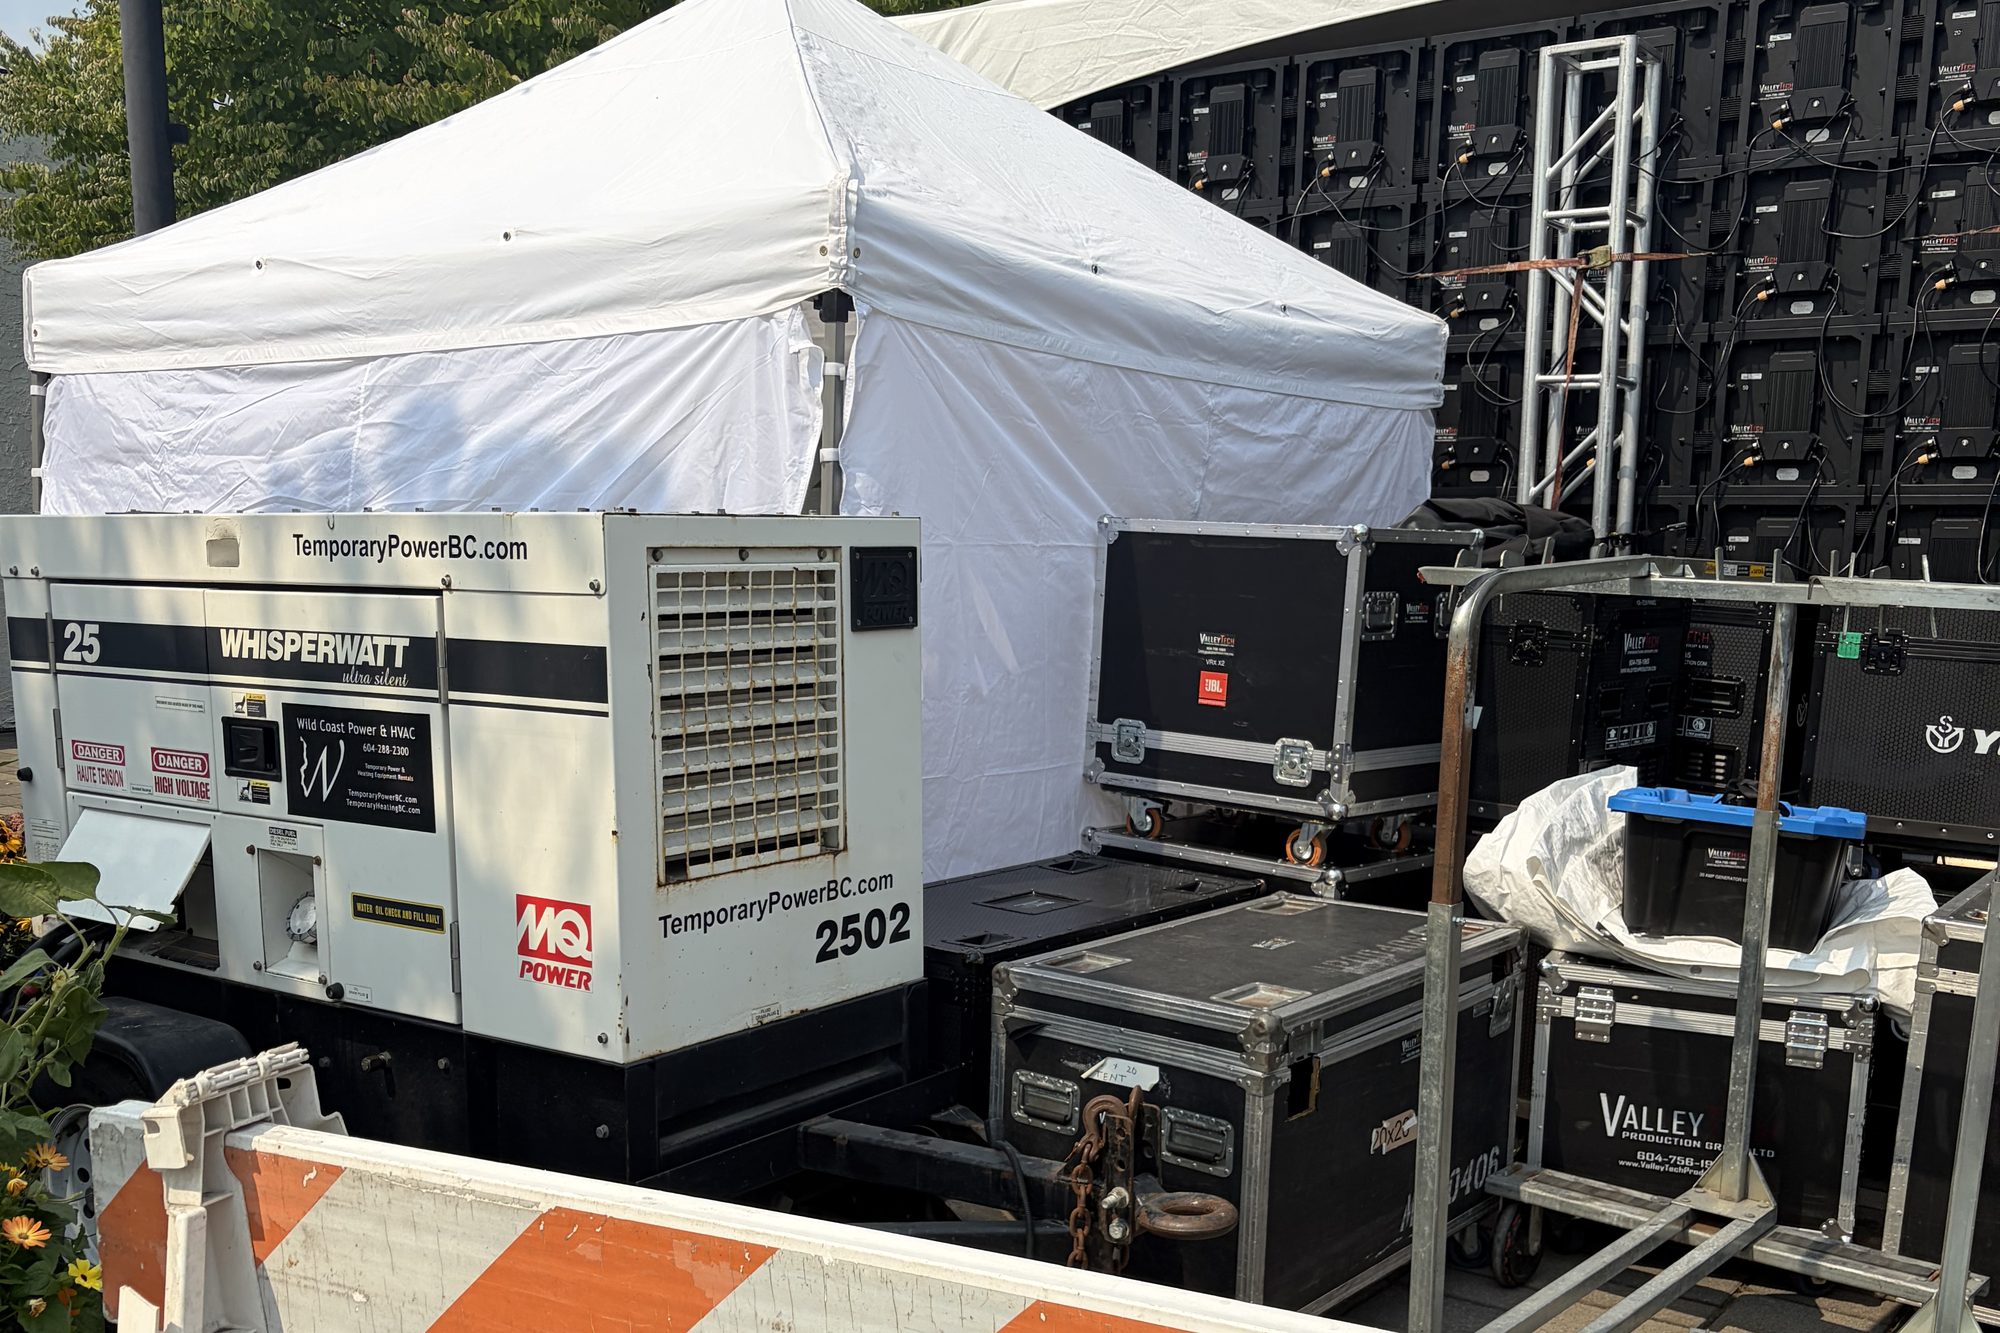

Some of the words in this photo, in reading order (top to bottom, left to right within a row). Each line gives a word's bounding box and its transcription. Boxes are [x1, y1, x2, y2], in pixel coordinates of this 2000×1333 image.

[293, 534, 528, 564] TemporaryPowerBC.com
[64, 622, 100, 663] 25
[220, 628, 409, 668] WHISPERWATT
[342, 661, 370, 686] ultra
[373, 668, 409, 688] silent
[1205, 679, 1222, 693] JBL
[296, 718, 316, 731] Wild
[320, 720, 345, 734] Coast
[348, 722, 376, 736] Power
[380, 724, 387, 737] &
[390, 726, 416, 739] HVAC
[78, 746, 120, 761] DANGER
[363, 743, 409, 756] 604-288-2300
[158, 754, 202, 770] DANGER
[76, 764, 97, 783] HAUTE
[98, 767, 124, 787] TENSION
[154, 776, 173, 794] HIGH
[175, 778, 210, 800] VOLTAGE
[347, 788, 418, 804] TemporaryPowerBC.com
[346, 798, 421, 814] TemporaryHeatingBC.com
[356, 903, 373, 913] WATER
[375, 905, 384, 915] OIL
[384, 907, 401, 918] CHECK
[402, 909, 412, 920] AND
[413, 911, 425, 922] FILL
[425, 913, 440, 924] DAILY
[658, 873, 894, 939] TemporaryPowerBC.com
[516, 903, 593, 961] MQ
[815, 902, 911, 964] 2502
[519, 960, 592, 991] POWER
[1094, 1070, 1127, 1082] TENT
[1622, 1131, 1700, 1148] PRODUCTION
